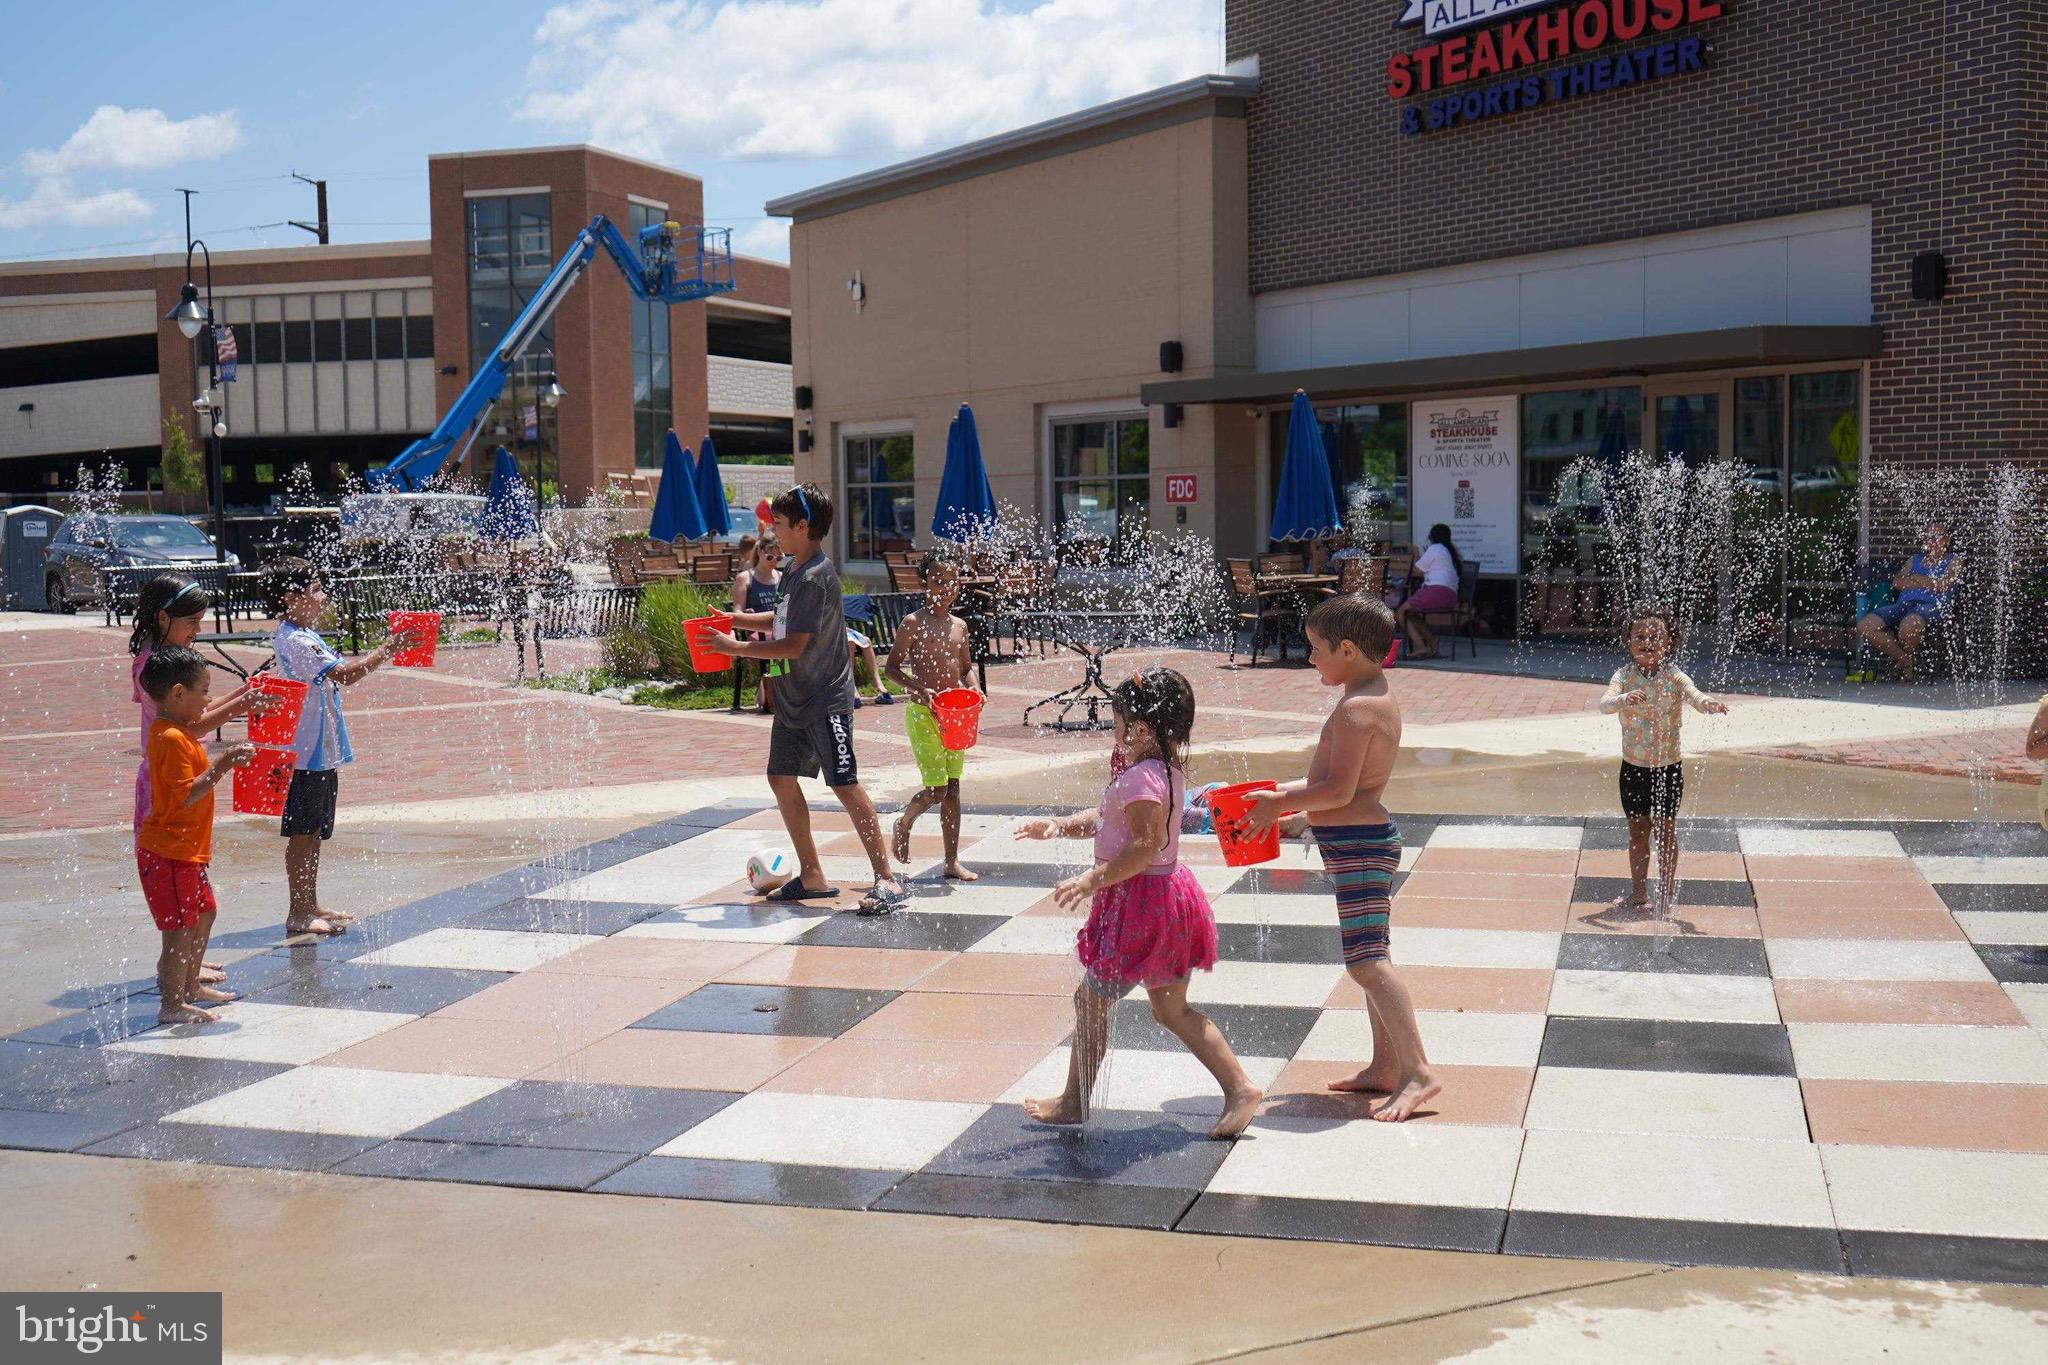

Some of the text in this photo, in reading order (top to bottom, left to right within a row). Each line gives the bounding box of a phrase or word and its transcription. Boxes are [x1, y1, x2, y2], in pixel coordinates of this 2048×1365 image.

[1432, 0, 1485, 29] ALL
[1402, 38, 1702, 135] & SPORTS THEATER
[1430, 426, 1498, 438] STEAKHOUSE
[1418, 451, 1511, 469] COMING SOON
[1169, 479, 1194, 498] FDC
